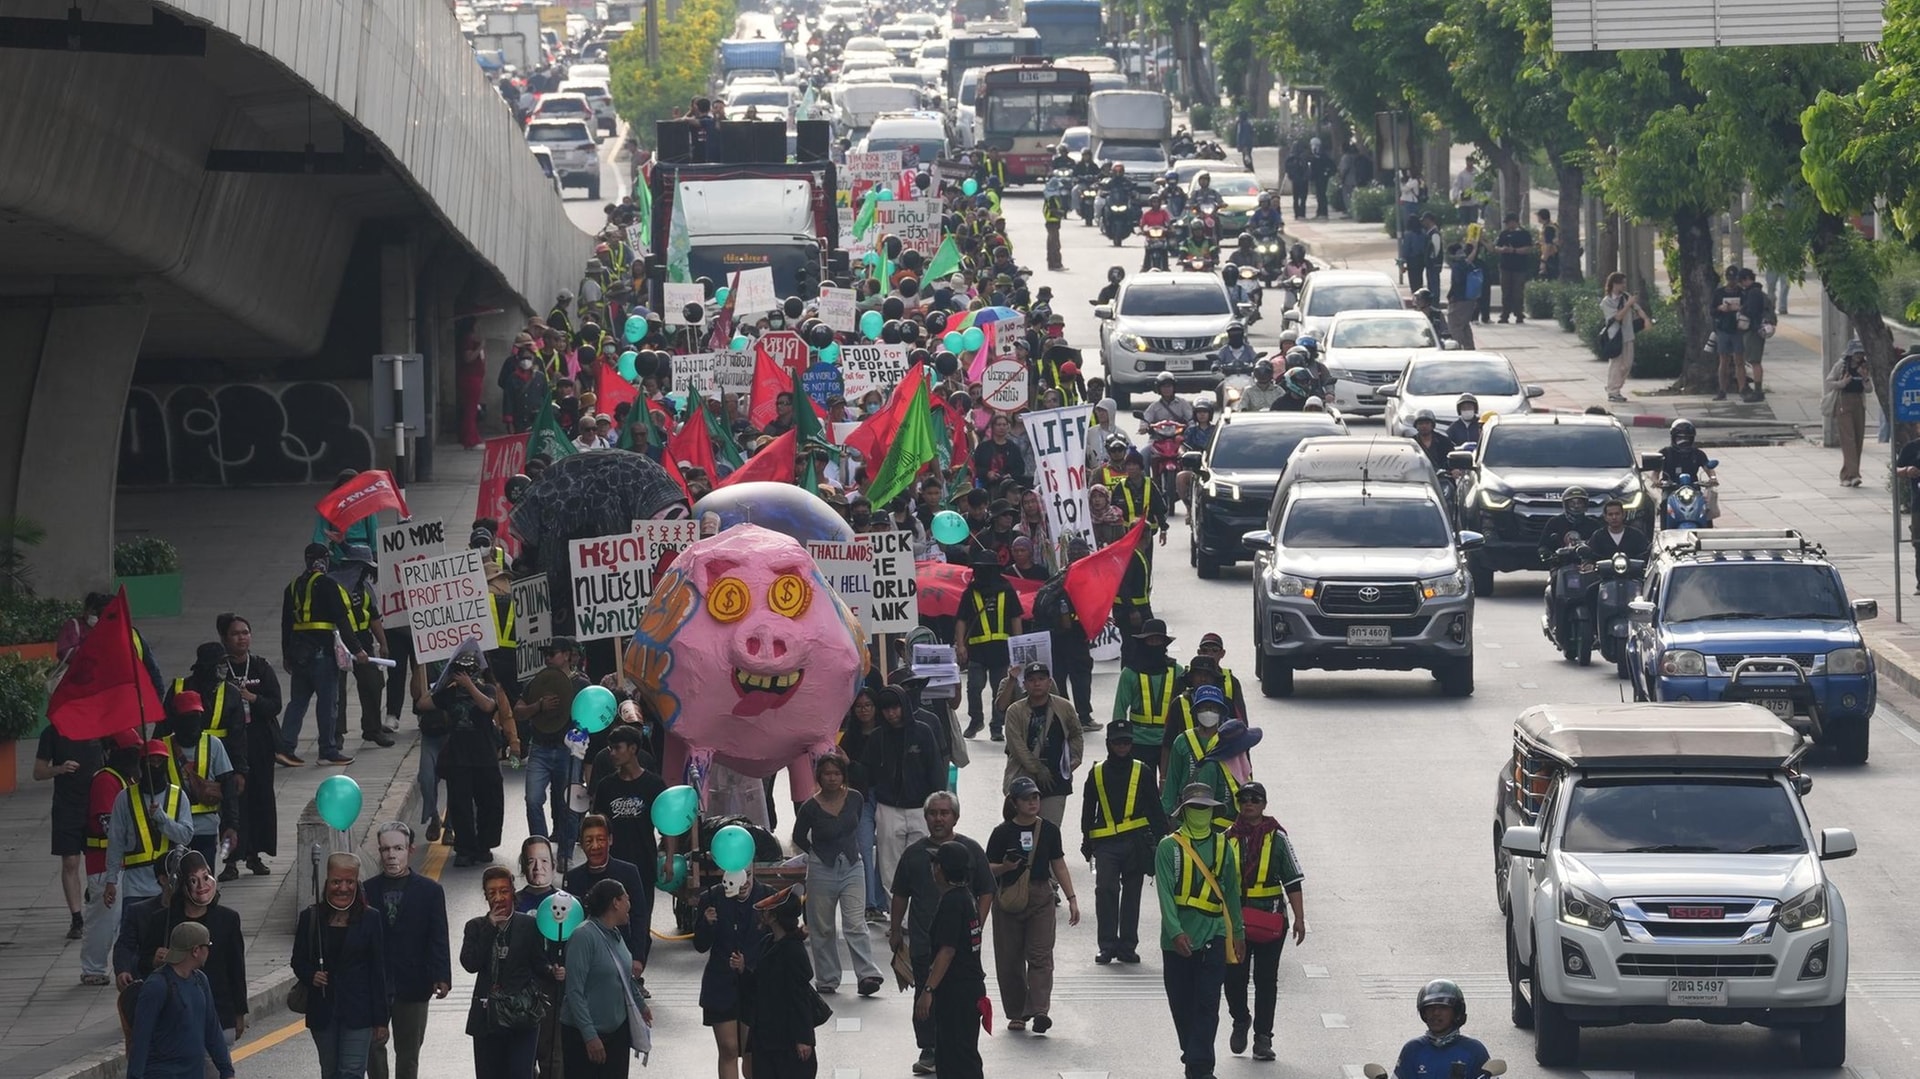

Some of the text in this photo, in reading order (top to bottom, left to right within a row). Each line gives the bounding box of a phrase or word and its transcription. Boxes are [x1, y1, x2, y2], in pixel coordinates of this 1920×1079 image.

[842, 348, 901, 361] FOOD for
[802, 371, 837, 381] OUR WORLD
[869, 370, 906, 383] PROFI
[811, 383, 827, 391] NOT
[828, 382, 840, 391] FOR
[484, 441, 523, 481] LAND
[1043, 460, 1058, 493] is
[382, 521, 445, 553] NO MORE
[579, 536, 646, 572] หยุด!
[808, 543, 873, 562] THAILAND'S
[404, 552, 479, 586] PRIVATIZE
[408, 577, 481, 608] PROFITS,
[841, 574, 871, 593] HELL
[873, 578, 917, 599] ORLD
[412, 598, 488, 630] SOCIALIZE
[872, 601, 910, 621] ANK
[417, 622, 483, 654] LOSSES
[1369, 628, 1388, 637] 4607
[1767, 700, 1789, 710] 3757
[1671, 907, 1723, 919] ISUZU
[1697, 981, 1724, 992] 5497
